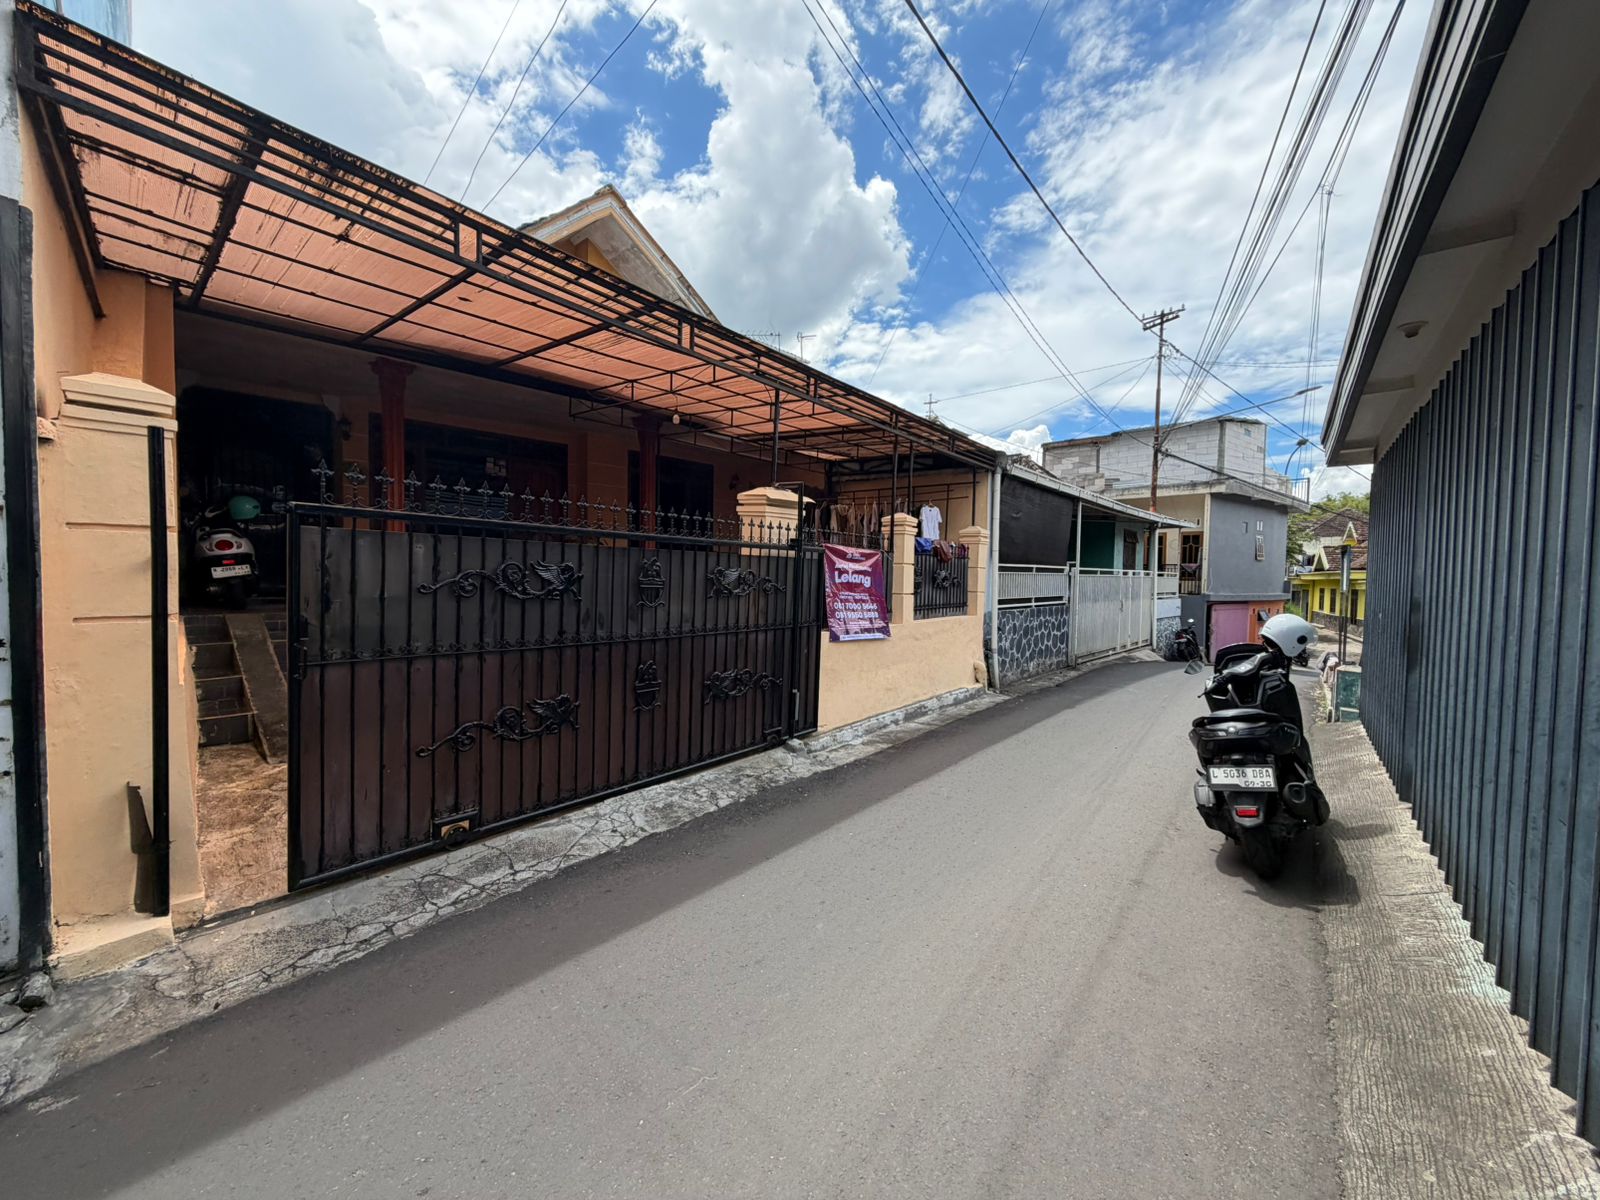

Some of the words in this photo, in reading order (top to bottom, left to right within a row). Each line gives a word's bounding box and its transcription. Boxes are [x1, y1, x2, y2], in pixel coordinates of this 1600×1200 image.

[834, 570, 872, 588] Lelang
[1212, 769, 1218, 779] L
[1252, 769, 1271, 779] DBA
